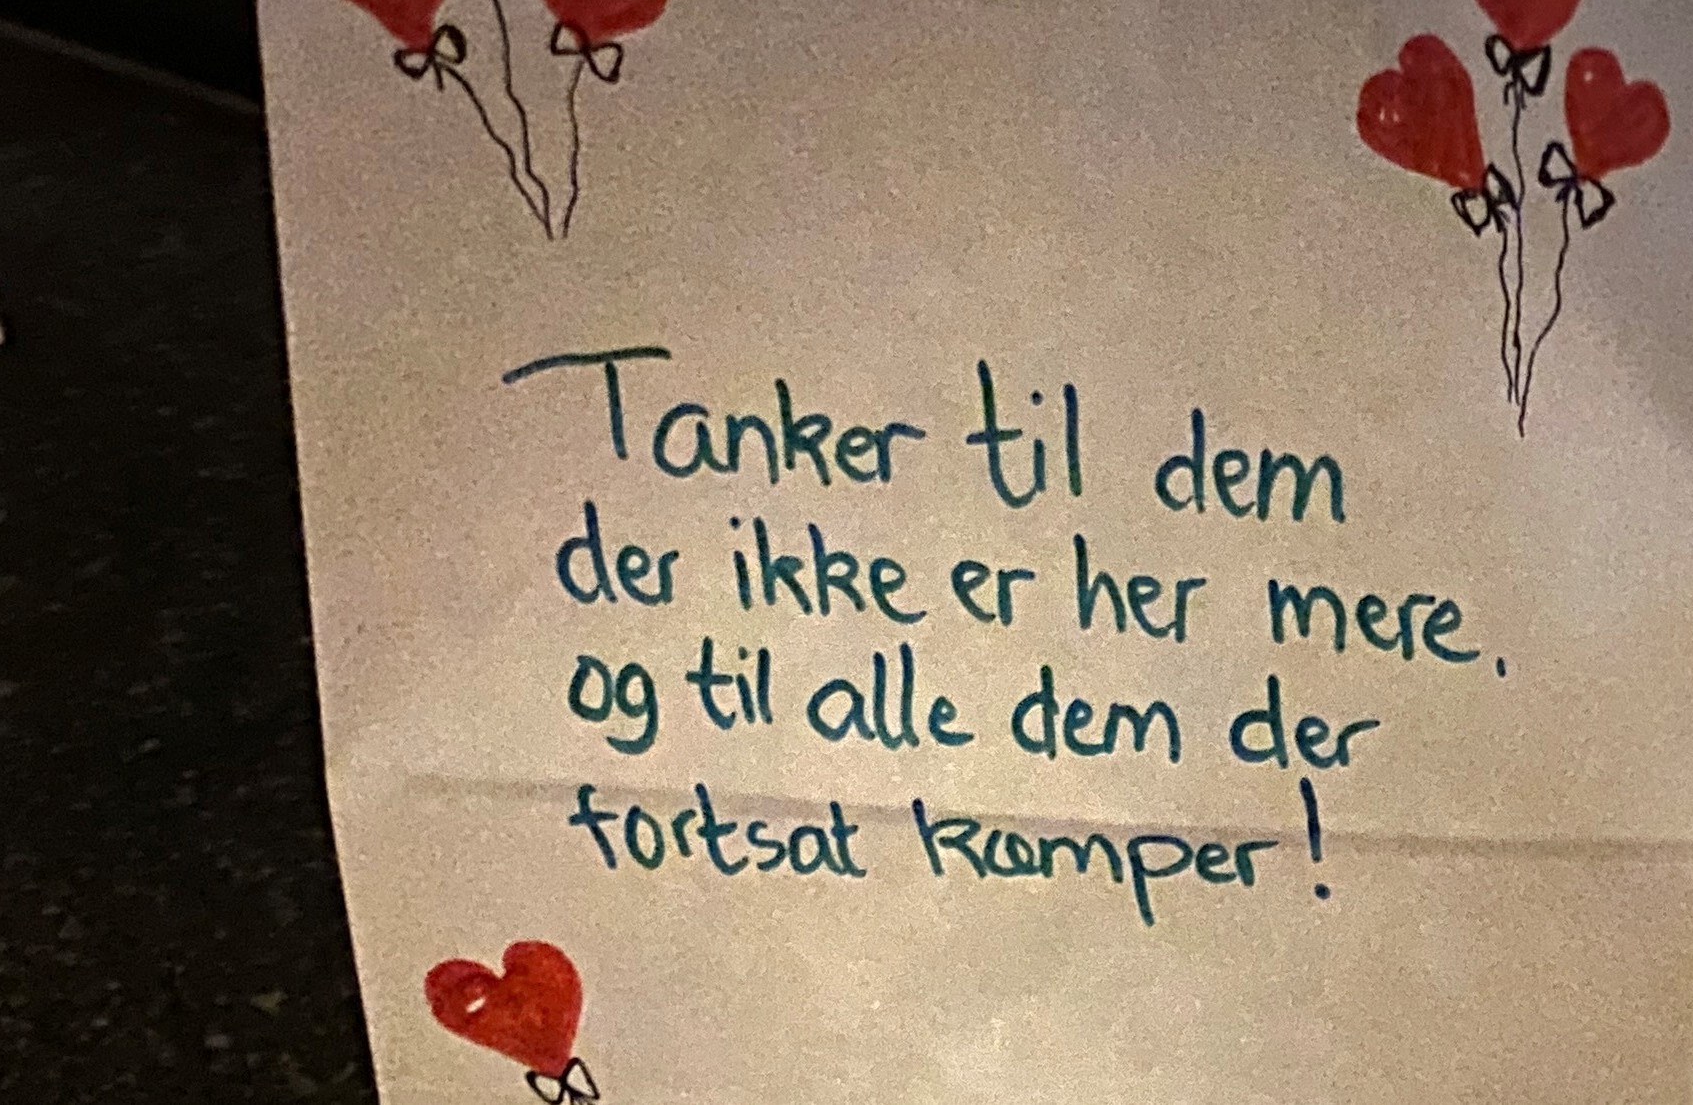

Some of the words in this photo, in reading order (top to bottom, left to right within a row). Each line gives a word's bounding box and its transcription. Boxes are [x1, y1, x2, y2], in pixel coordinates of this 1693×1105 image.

[500, 344, 927, 487] Tanker
[965, 358, 1083, 510] til
[1154, 406, 1347, 524] dem
[555, 498, 680, 607] der
[728, 515, 928, 625] ikke
[949, 558, 1037, 628] er
[1072, 532, 1208, 644] her
[567, 653, 659, 753] og
[685, 635, 774, 725] til
[805, 641, 975, 749] alle
[1010, 663, 1182, 764] dem
[1228, 673, 1381, 770] der
[567, 782, 868, 878] fortsat
